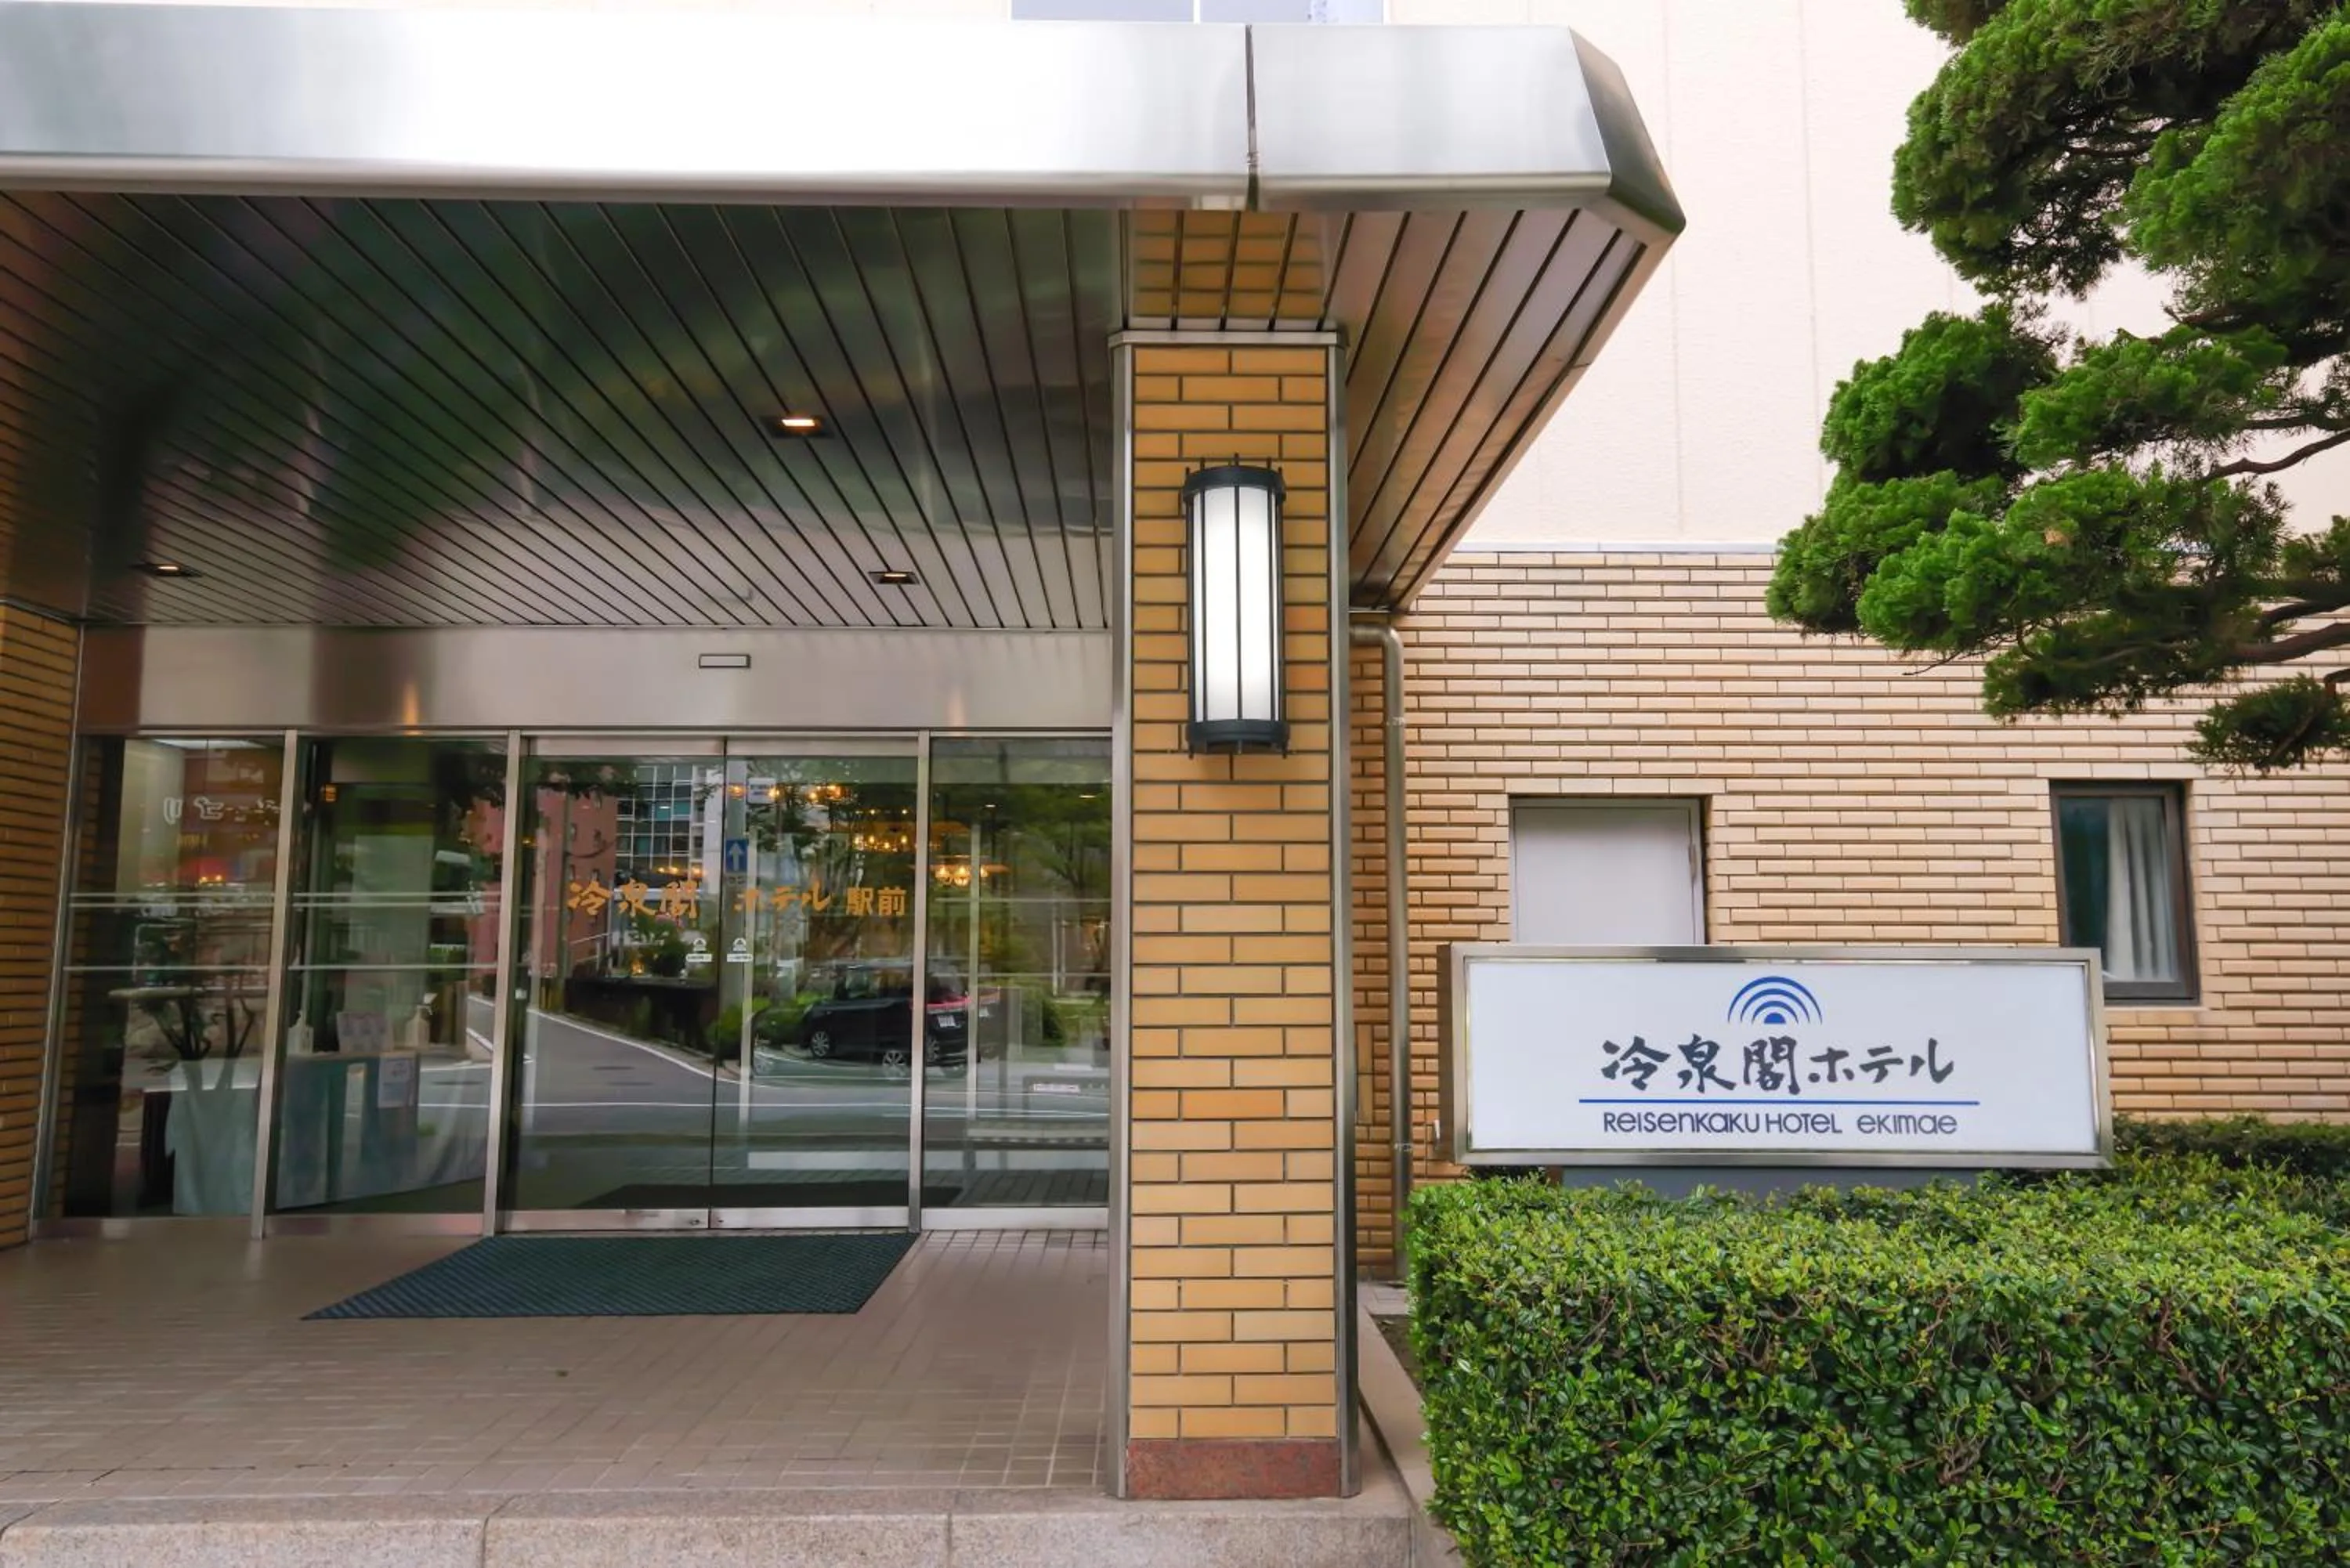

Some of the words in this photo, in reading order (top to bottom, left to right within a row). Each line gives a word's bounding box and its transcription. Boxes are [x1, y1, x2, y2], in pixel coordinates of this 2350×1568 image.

[846, 886, 906, 916] 駅前
[1601, 1035, 1954, 1095] 冷泉閣ホテル
